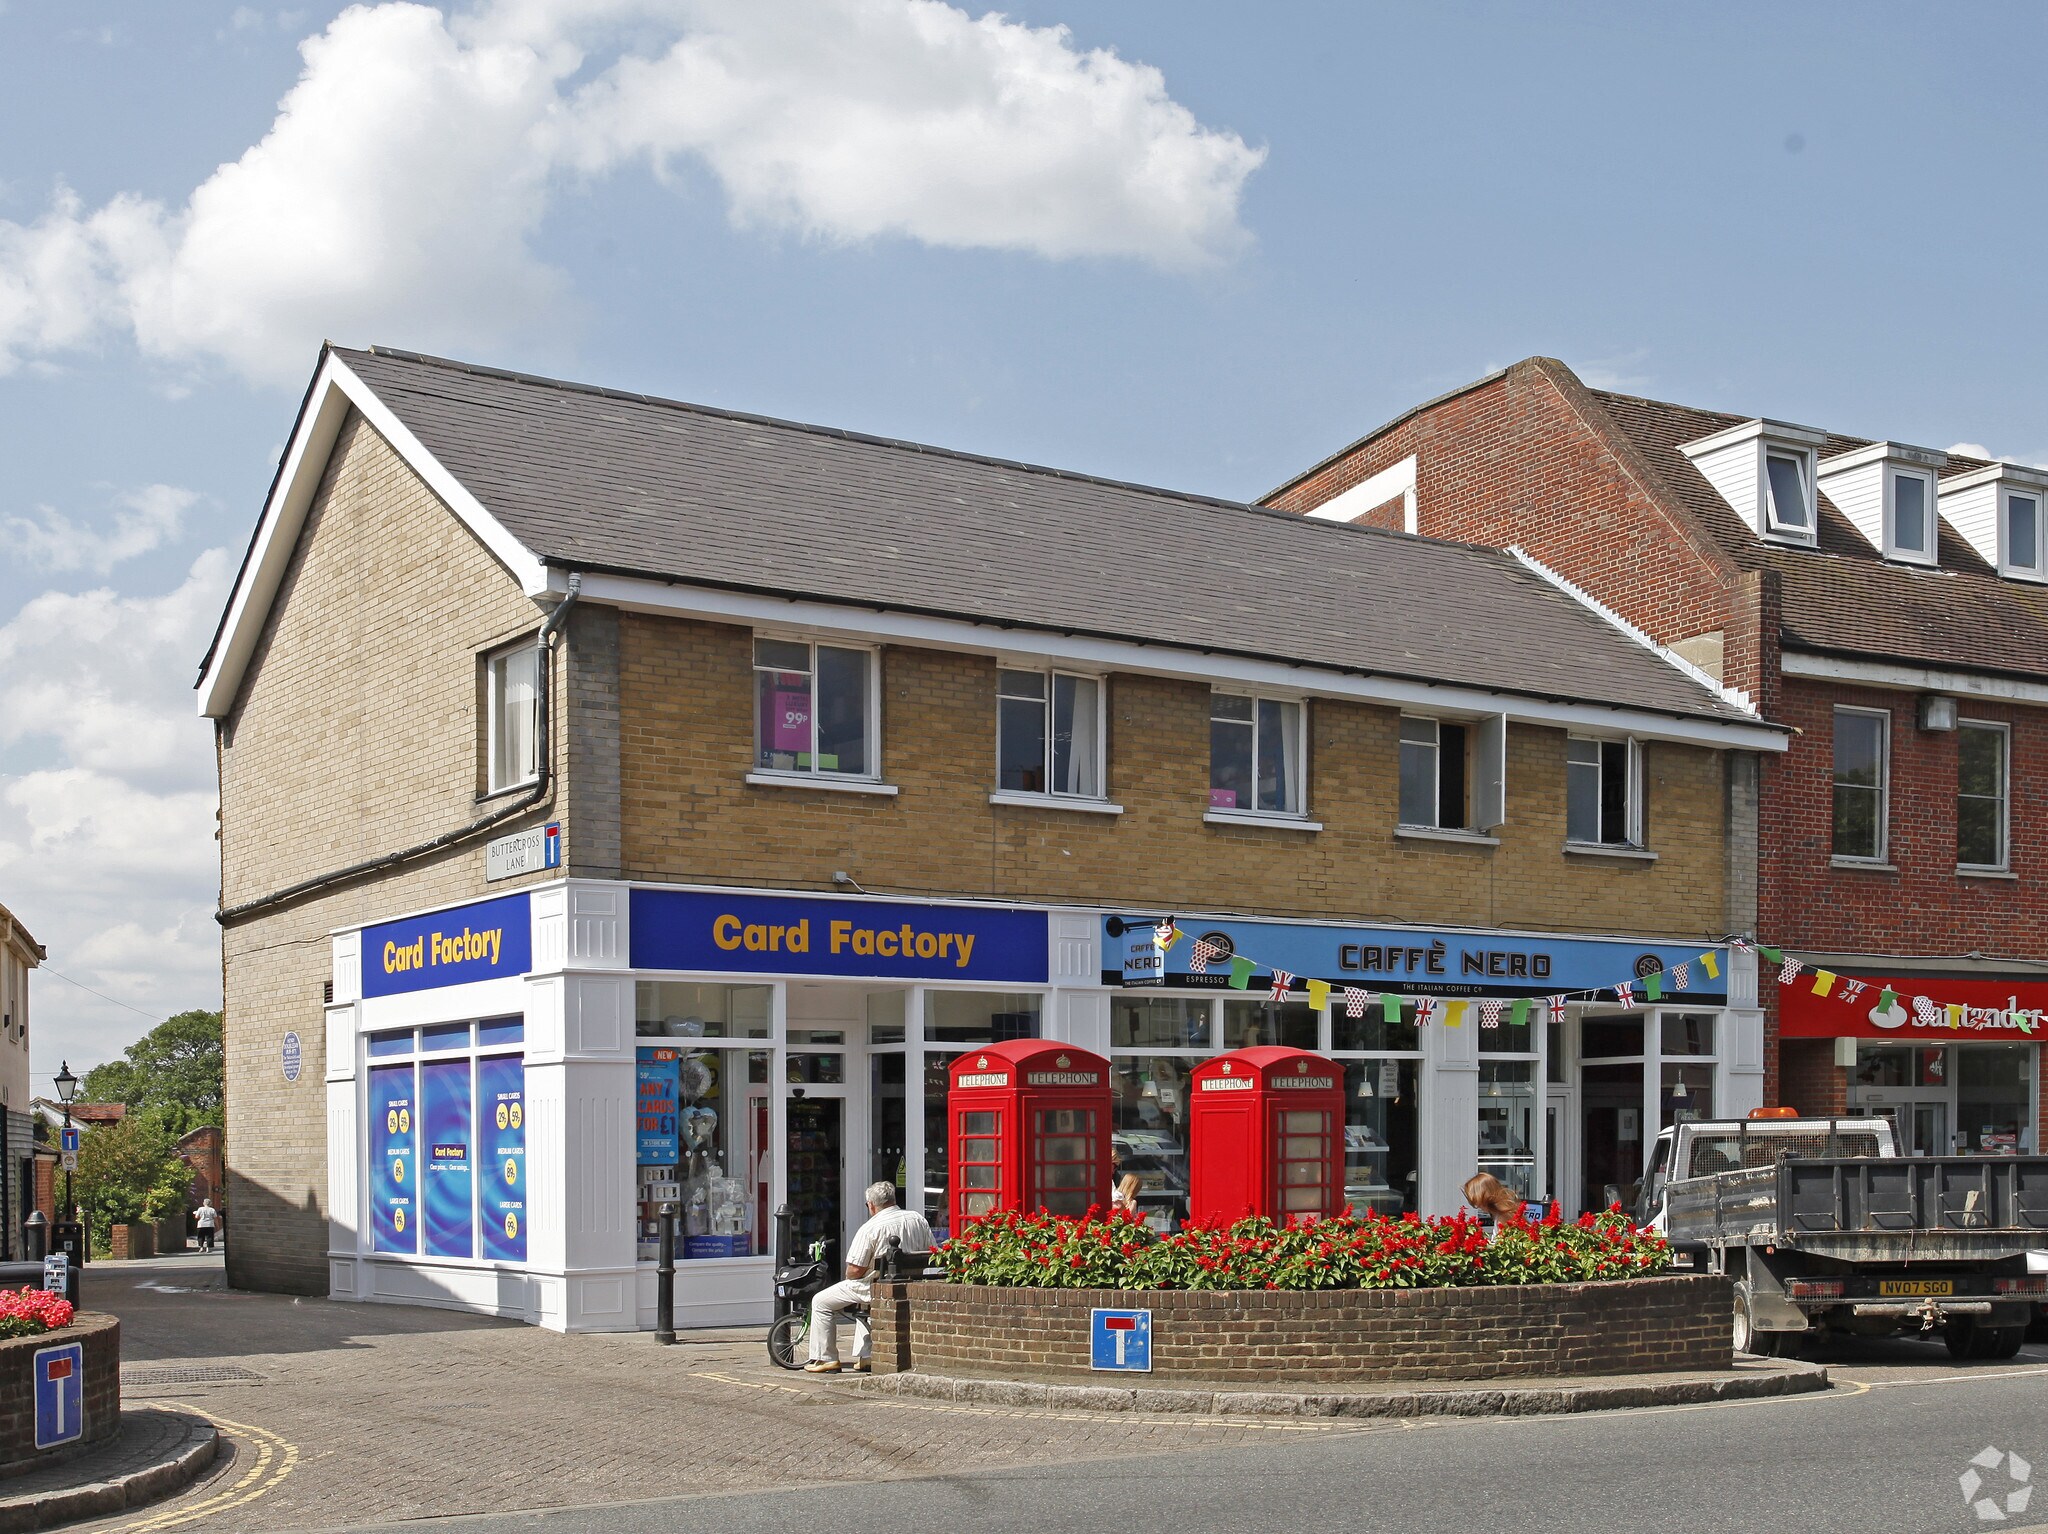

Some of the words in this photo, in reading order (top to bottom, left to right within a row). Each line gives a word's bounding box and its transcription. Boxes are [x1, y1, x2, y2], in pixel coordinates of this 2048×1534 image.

[491, 835, 540, 858] BUTTERCROSS
[506, 855, 525, 871] LANE
[713, 914, 809, 953] Card
[830, 920, 976, 968] Factory
[384, 935, 424, 974] Card
[431, 927, 503, 965] Factory
[1124, 956, 1161, 970] NERO
[1339, 939, 1447, 975] CAFFÈ
[1461, 949, 1552, 979] NERO
[1186, 975, 1225, 984] ESPRESSO
[1403, 983, 1415, 991] THE
[1417, 984, 1443, 992] ITALIAN
[1446, 985, 1471, 993] COFFEE
[657, 1050, 673, 1060] NEW
[961, 1074, 1006, 1087] TELEPHONE
[1030, 1073, 1095, 1084] TELEPHONE
[1204, 1078, 1252, 1090] TELEPHONE
[1273, 1077, 1332, 1088] TELEPHONE
[640, 1083, 663, 1097] ANY
[664, 1079, 673, 1098] 7
[637, 1100, 675, 1114] CARDS
[636, 1117, 659, 1131] FOR
[660, 1115, 676, 1135] £1
[435, 1147, 446, 1157] Card
[447, 1148, 464, 1159] Factory
[1885, 1282, 1920, 1293] NV07
[1923, 1281, 1948, 1293] SGO
